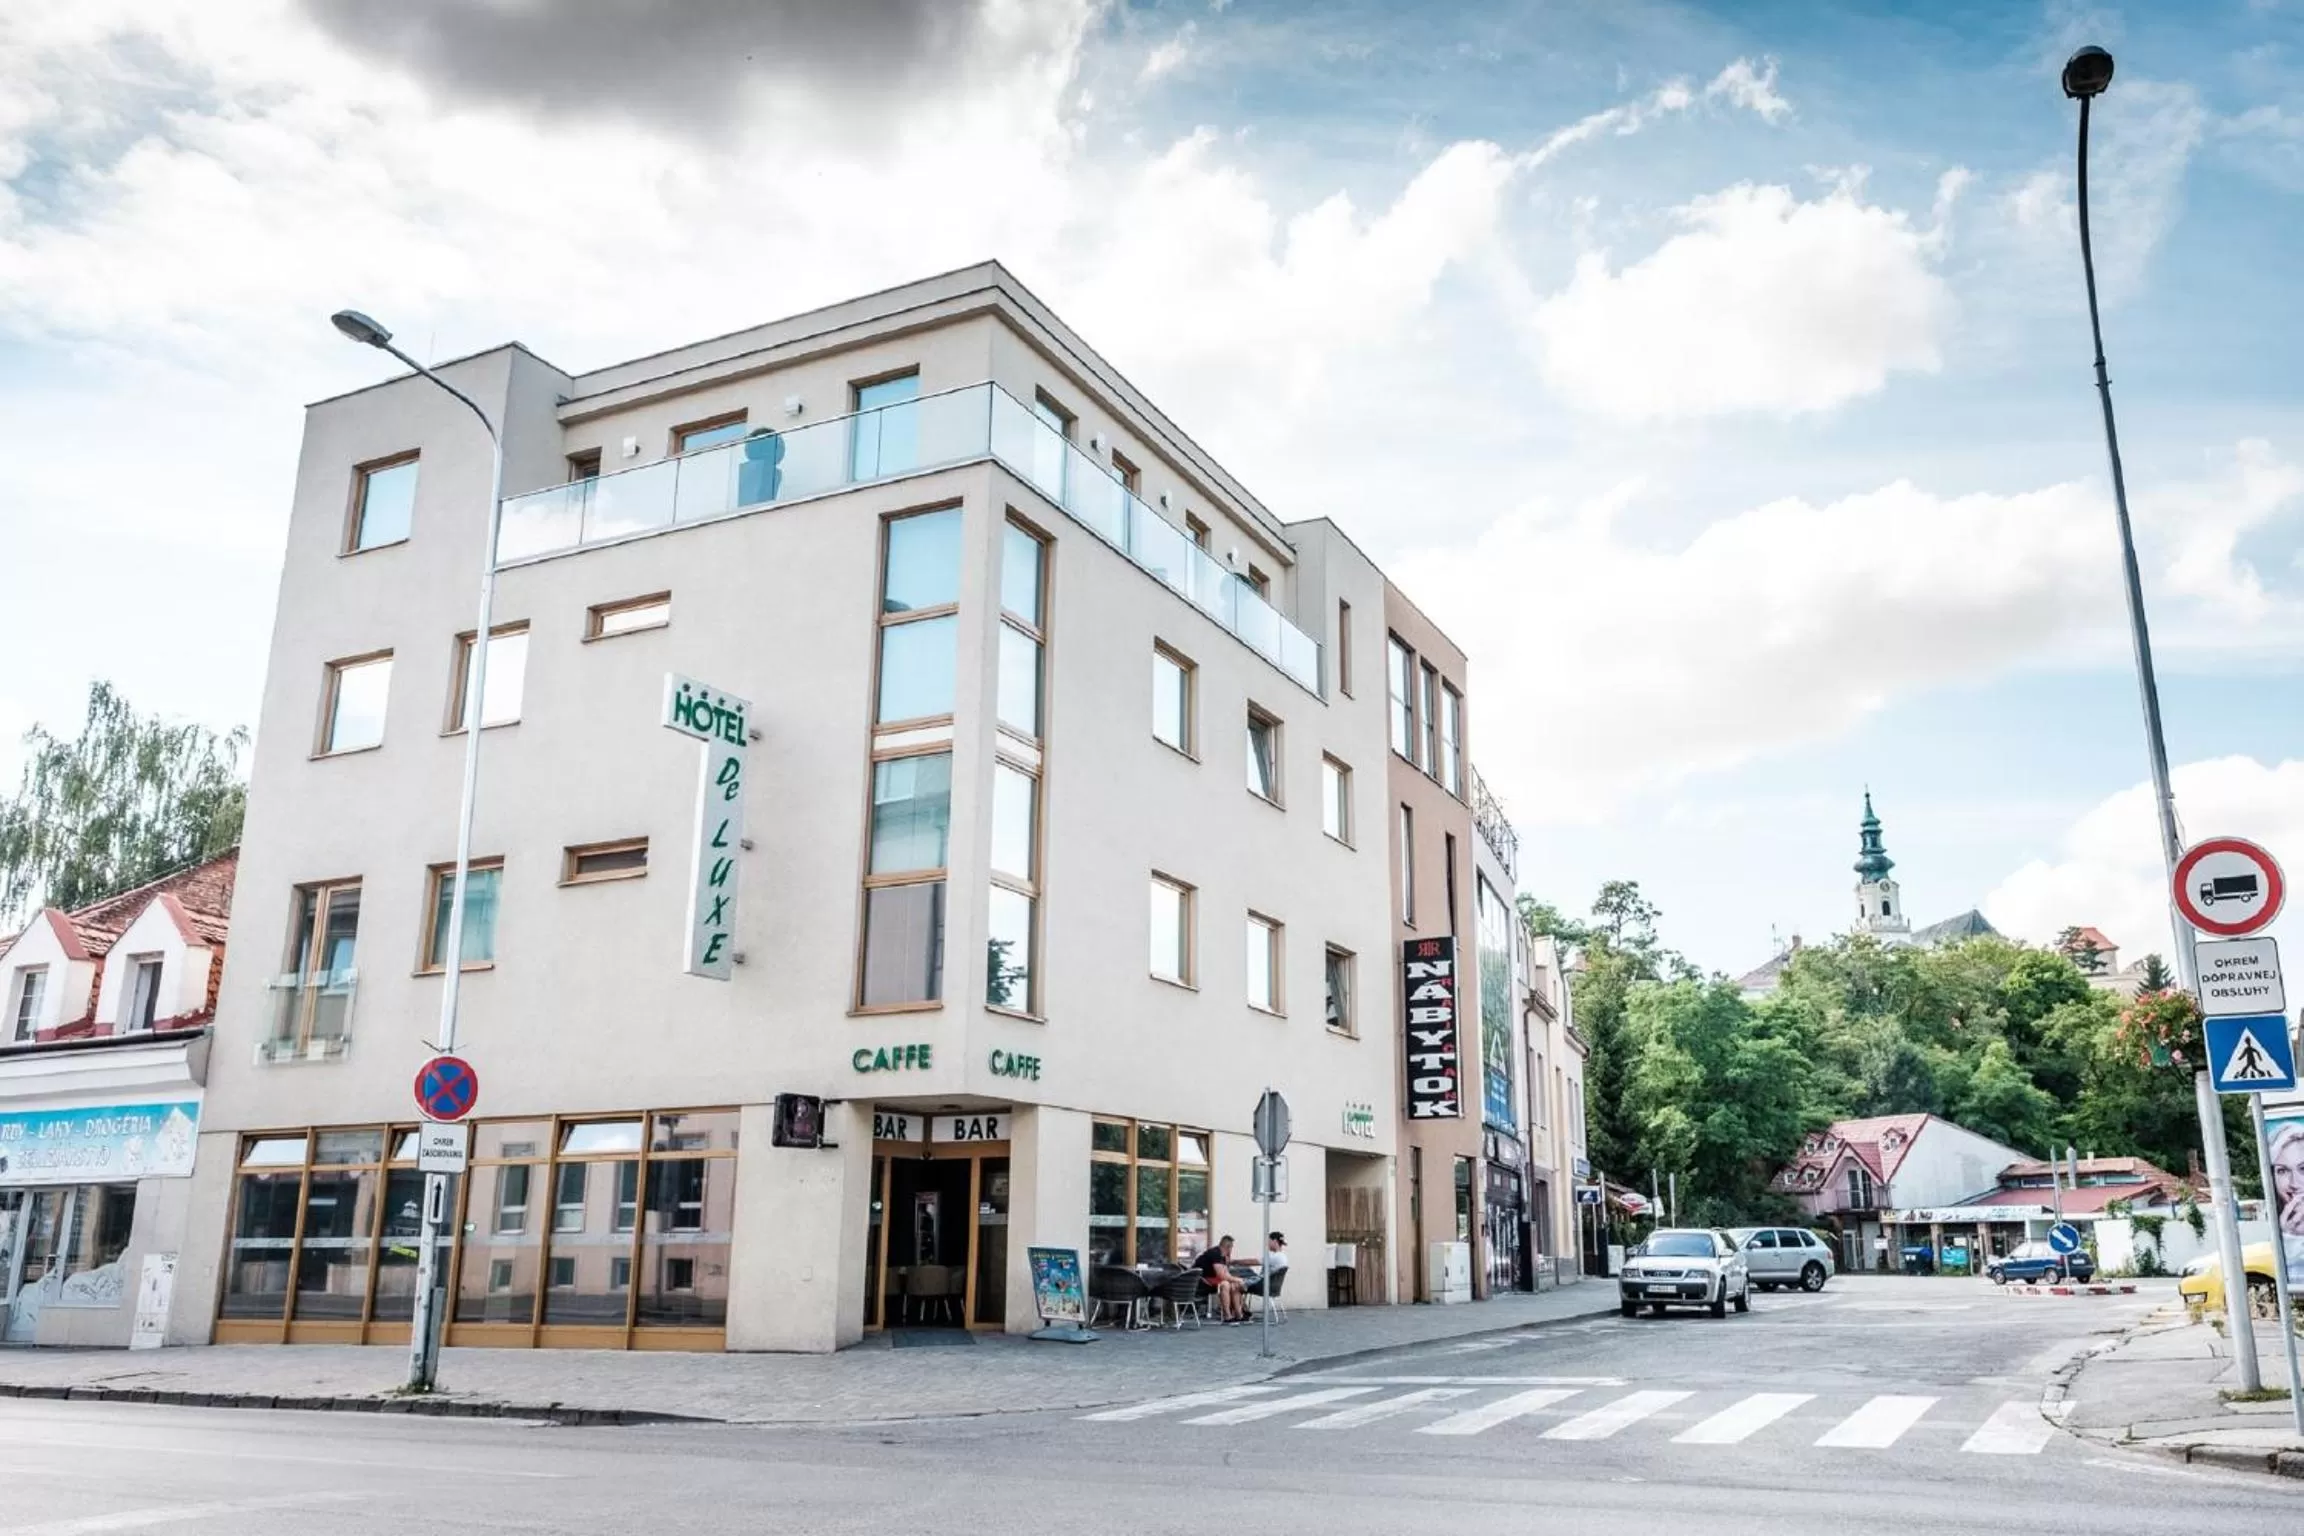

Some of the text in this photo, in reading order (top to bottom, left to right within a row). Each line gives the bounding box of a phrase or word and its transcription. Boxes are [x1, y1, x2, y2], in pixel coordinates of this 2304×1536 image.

[674, 691, 747, 747] HOTEL
[703, 757, 740, 964] De LUXE
[2214, 955, 2259, 968] OKREM
[2202, 970, 2276, 983] DOPRAVNEJ
[2211, 986, 2270, 997] OBSLUHY
[1407, 960, 1458, 1117] NÁBYTOK
[852, 1044, 932, 1073] CAFFE
[989, 1049, 1041, 1081] CAFFE
[873, 1114, 907, 1140] BAR
[954, 1116, 998, 1140] BAR
